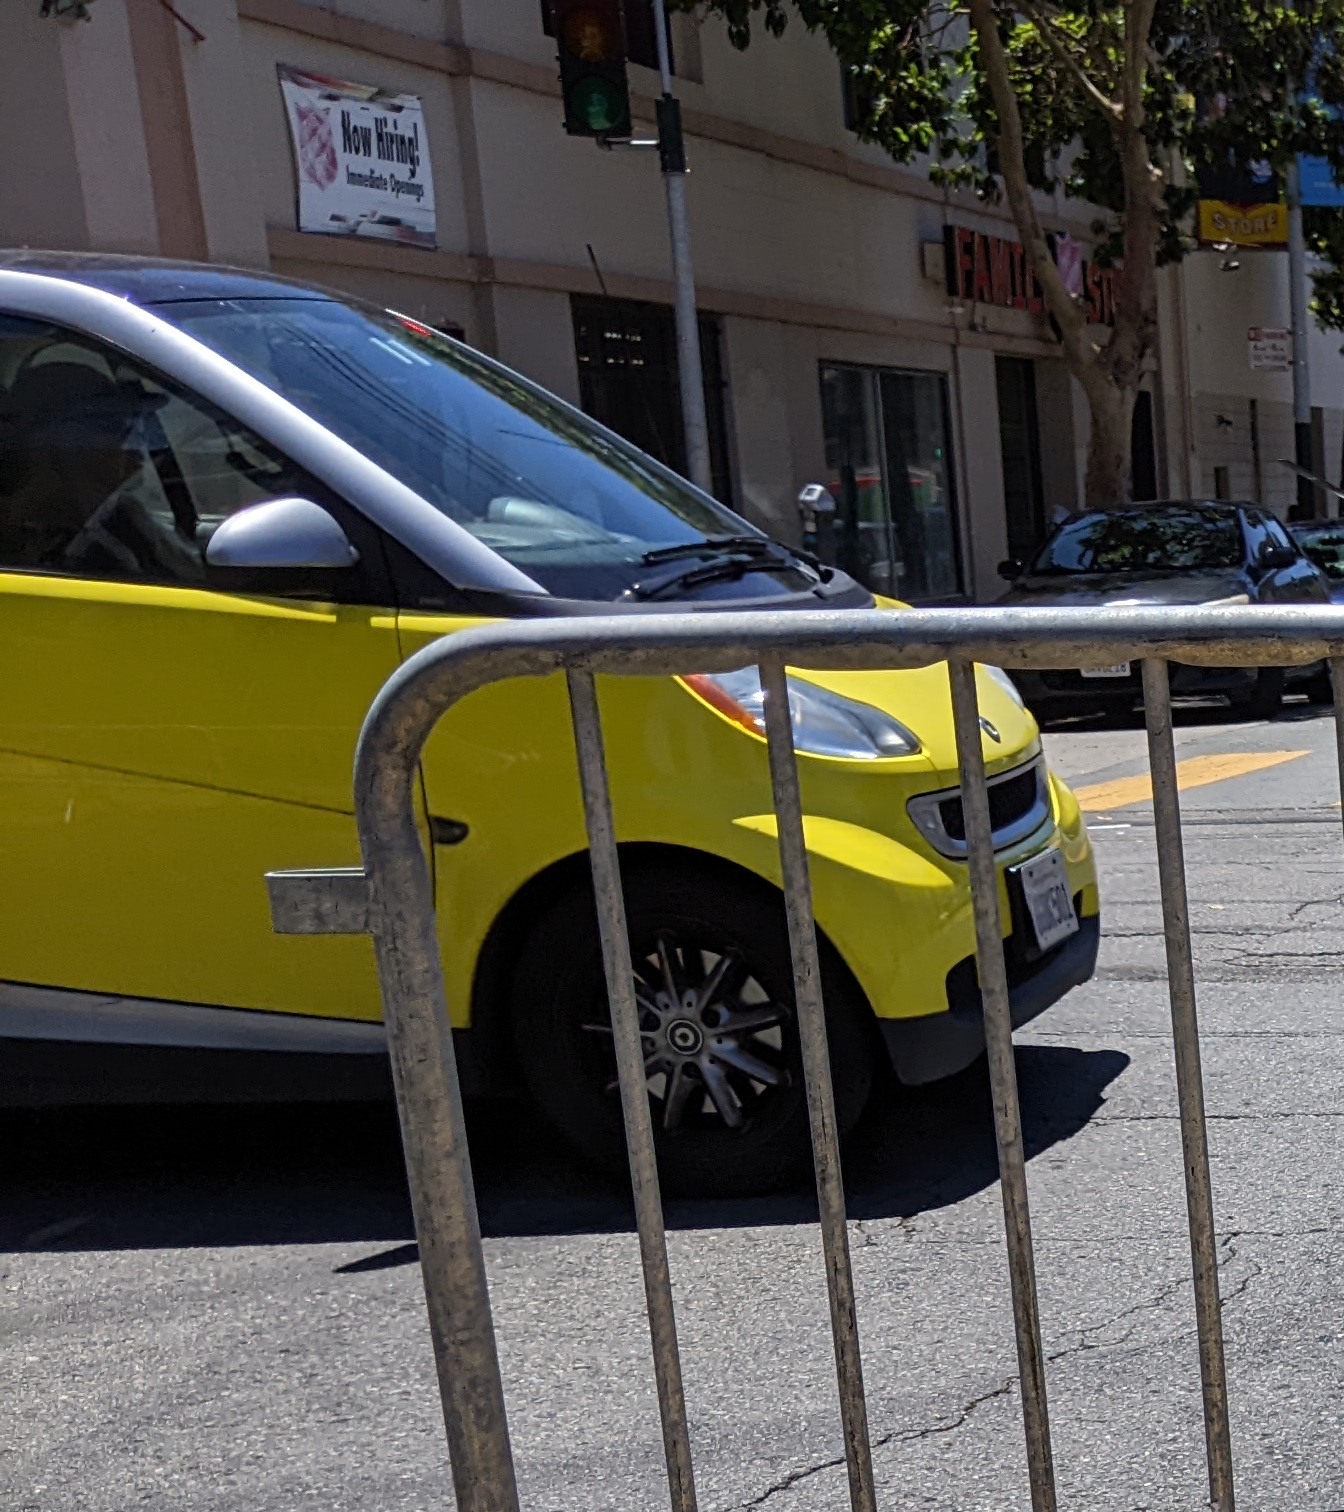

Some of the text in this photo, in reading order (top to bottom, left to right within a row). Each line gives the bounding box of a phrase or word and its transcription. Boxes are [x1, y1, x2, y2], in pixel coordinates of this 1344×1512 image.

[341, 110, 372, 158] Now
[374, 115, 420, 181] Hiring!
[346, 164, 425, 202] Immediate Openings
[1212, 212, 1278, 234] STORE
[955, 225, 1047, 315] FAMIL
